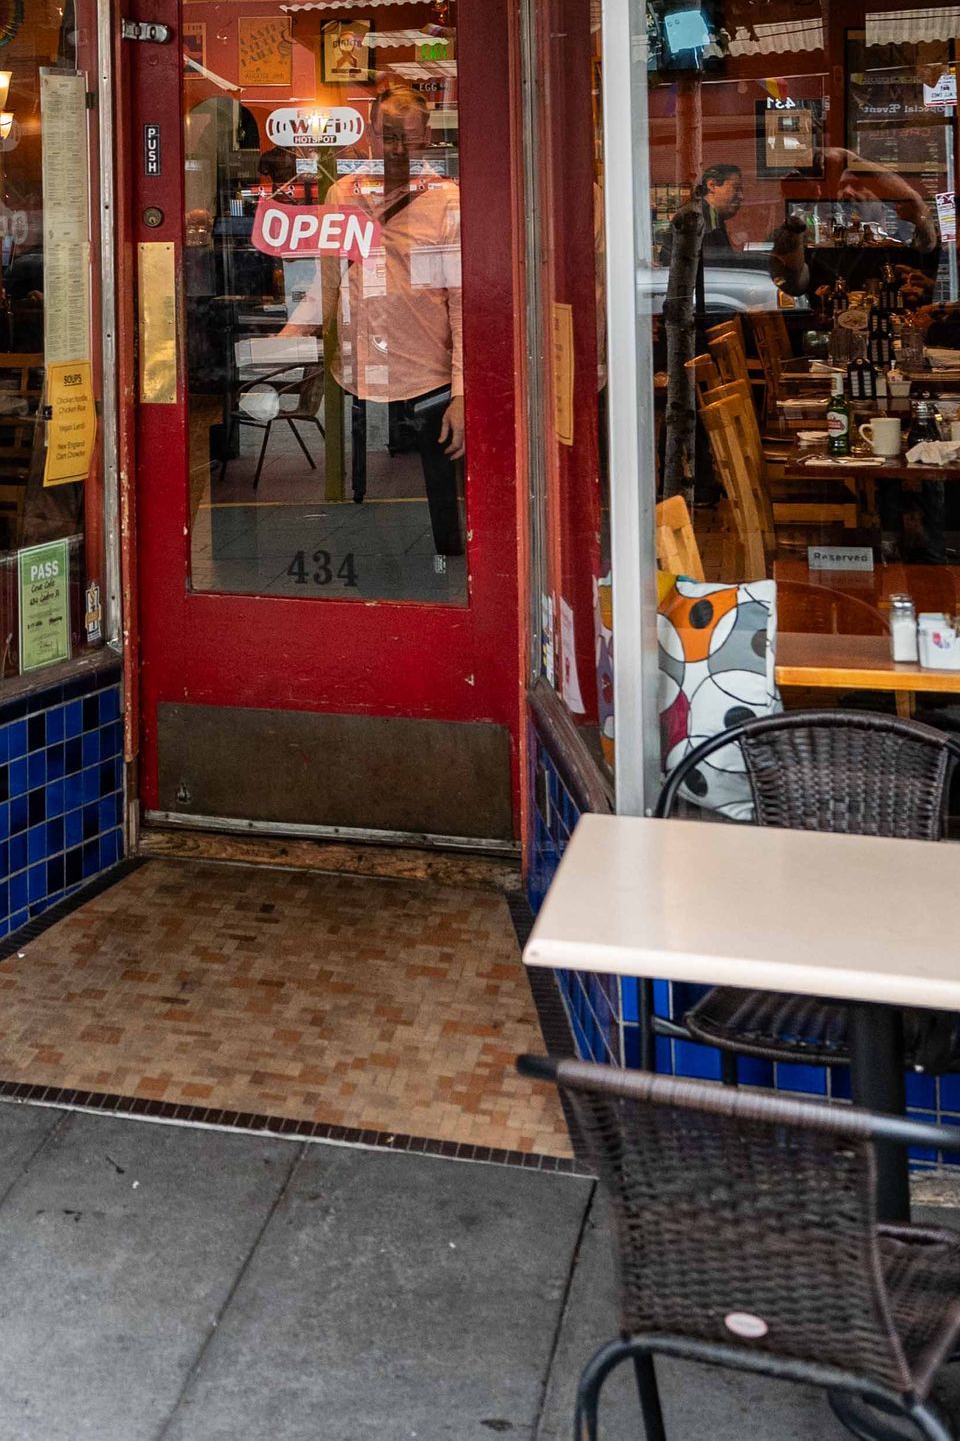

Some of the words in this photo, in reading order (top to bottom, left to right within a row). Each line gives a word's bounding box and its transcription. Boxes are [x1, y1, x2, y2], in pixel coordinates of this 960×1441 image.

[147, 127, 157, 173] PUSH
[293, 135, 337, 144] HOTSPOT
[262, 208, 374, 259] OPEN
[63, 374, 83, 385] SOUPS
[814, 552, 868, 562] Reserved
[31, 560, 59, 581] PASS
[286, 549, 359, 587] 434
